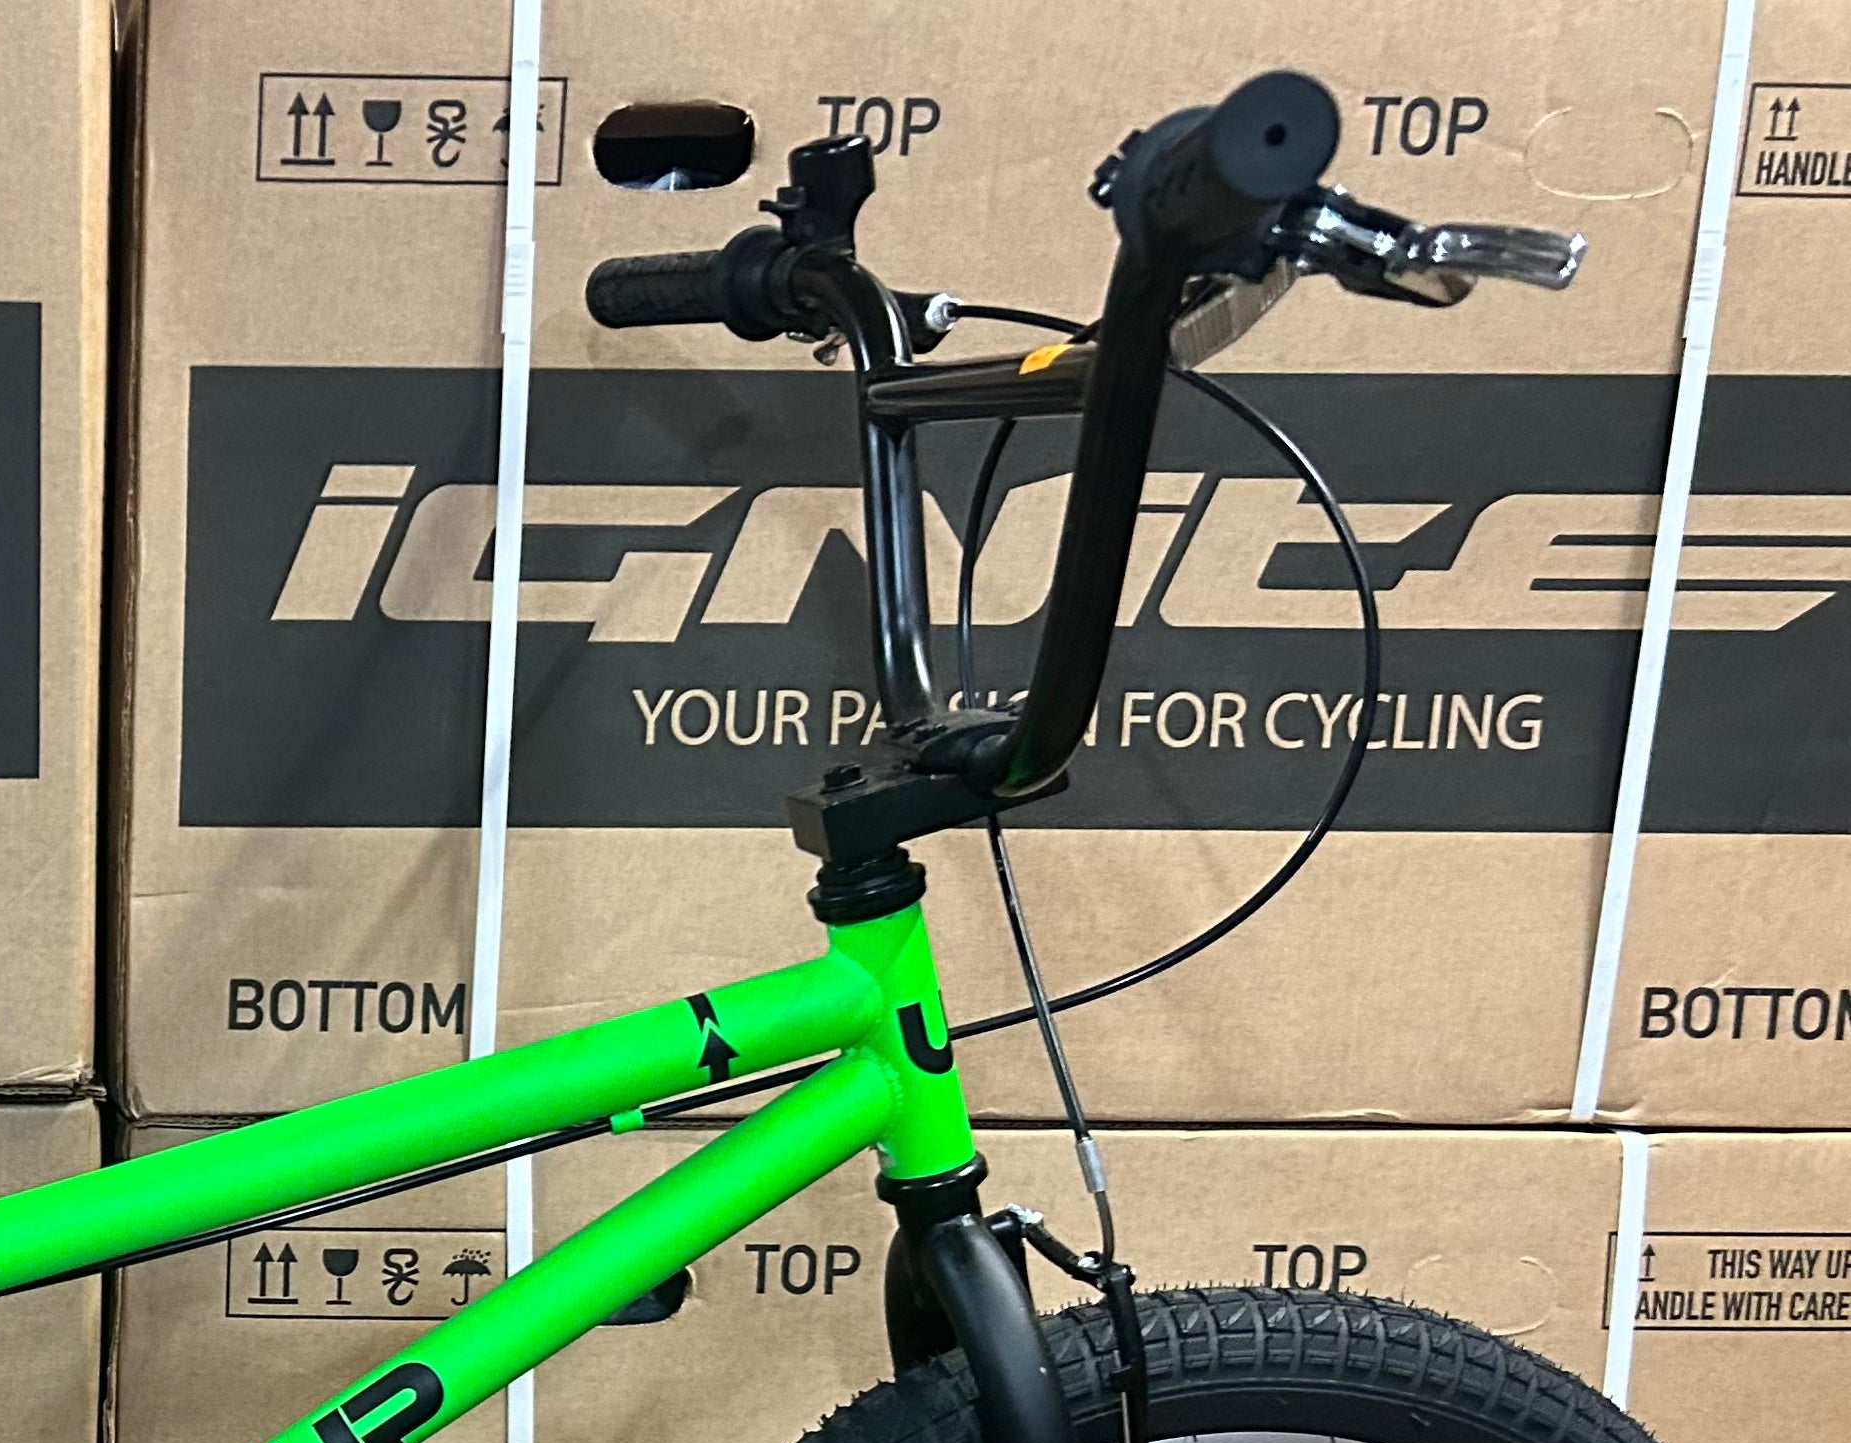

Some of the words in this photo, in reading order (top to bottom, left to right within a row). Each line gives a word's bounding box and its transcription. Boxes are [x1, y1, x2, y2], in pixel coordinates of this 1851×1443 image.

[817, 96, 942, 157] TOP
[1363, 96, 1490, 157] TOP
[633, 688, 810, 746] YOUR
[1119, 691, 1247, 750] FOR
[1264, 692, 1545, 751] CYCLING
[228, 978, 467, 1036] BOTTOM
[744, 1244, 862, 1297] TOP
[1252, 1244, 1369, 1291] TOP
[1707, 1249, 1762, 1280] THIS
[1769, 1250, 1822, 1280] WAY
[1634, 1290, 1715, 1321] ANDLE
[1722, 1291, 1783, 1321] WITH
[1788, 1291, 1851, 1322] CARE
